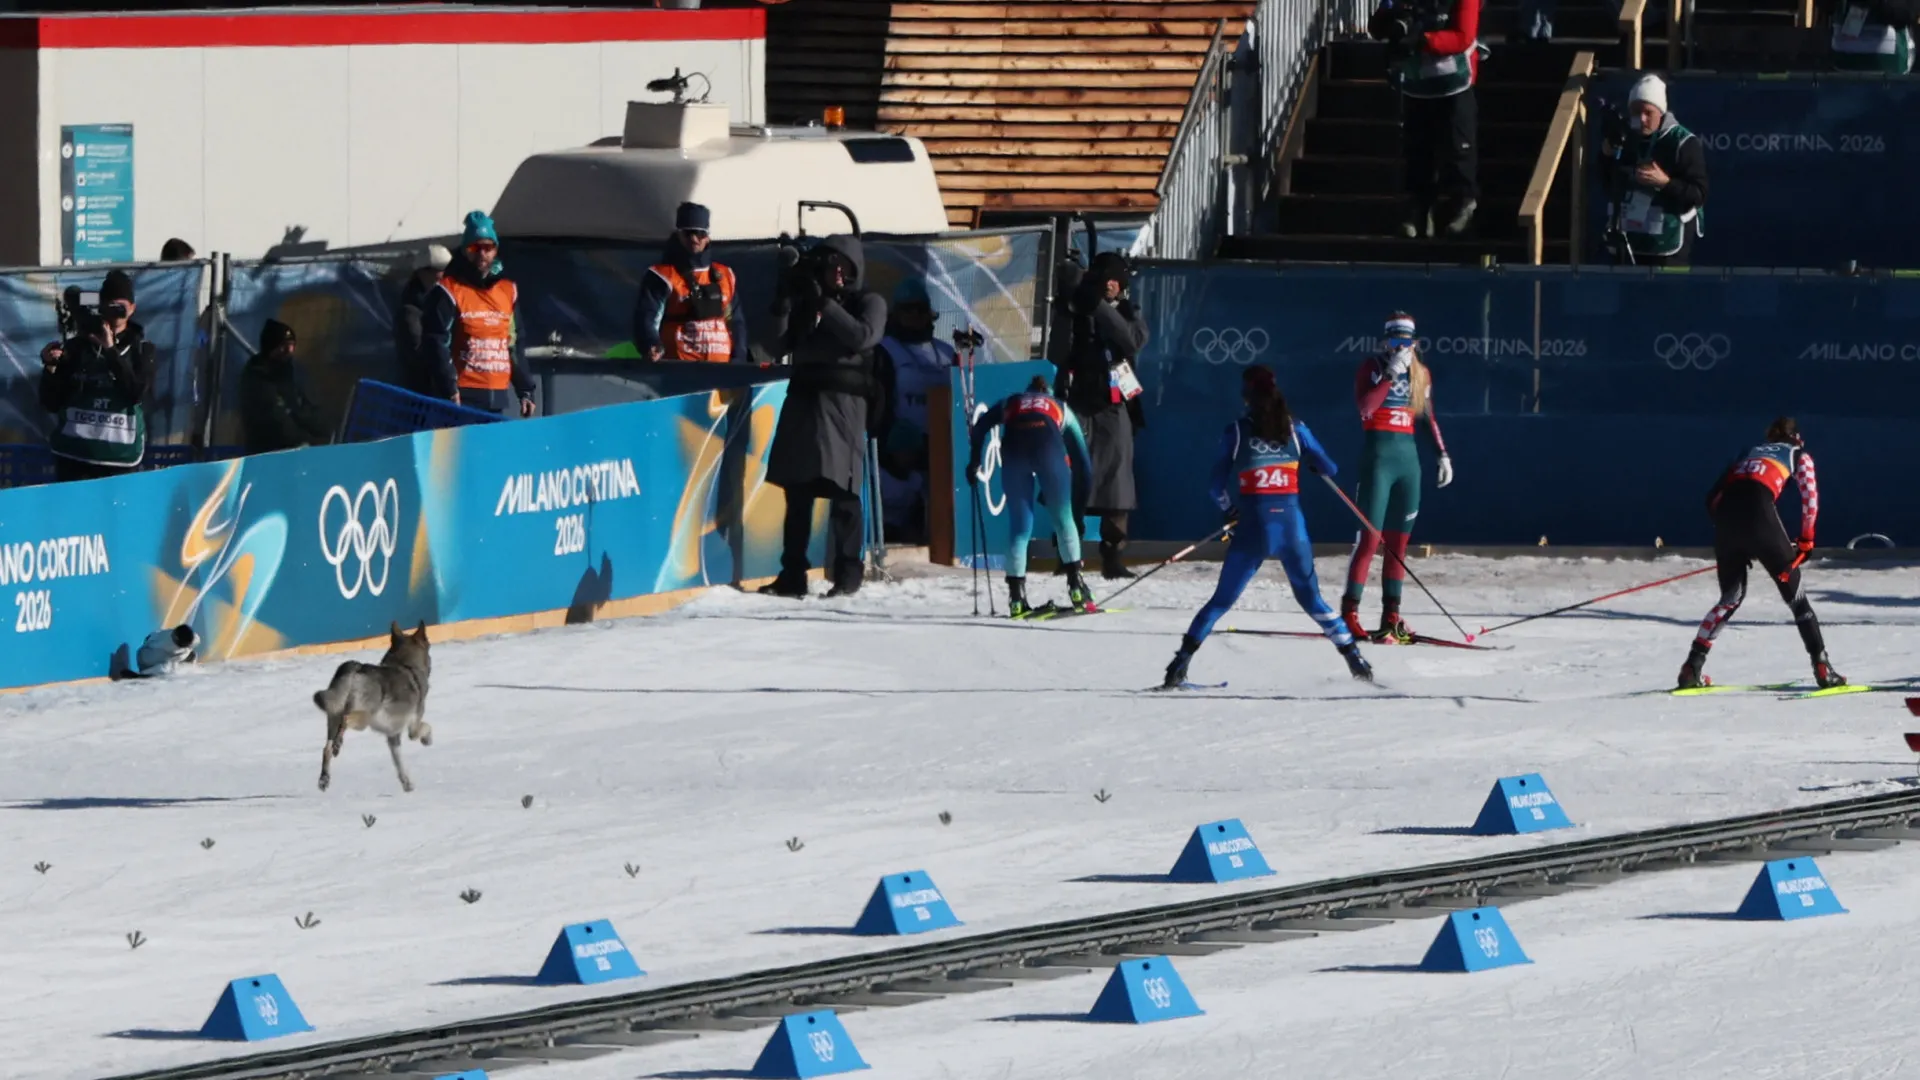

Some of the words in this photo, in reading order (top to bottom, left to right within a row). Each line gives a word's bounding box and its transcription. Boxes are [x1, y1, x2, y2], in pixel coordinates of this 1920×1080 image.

[1736, 133, 1834, 153] CORTINA
[1839, 135, 1885, 152] 2026
[1436, 336, 1535, 354] CORTINA
[1541, 339, 1587, 355] 2026
[1797, 343, 1895, 361] MILANO
[1900, 344, 1920, 361] C
[495, 468, 571, 516] MILANO
[572, 458, 641, 506] CORTINA
[554, 513, 585, 556] 2026
[37, 533, 109, 582] CORTINA
[15, 590, 51, 632] 2026
